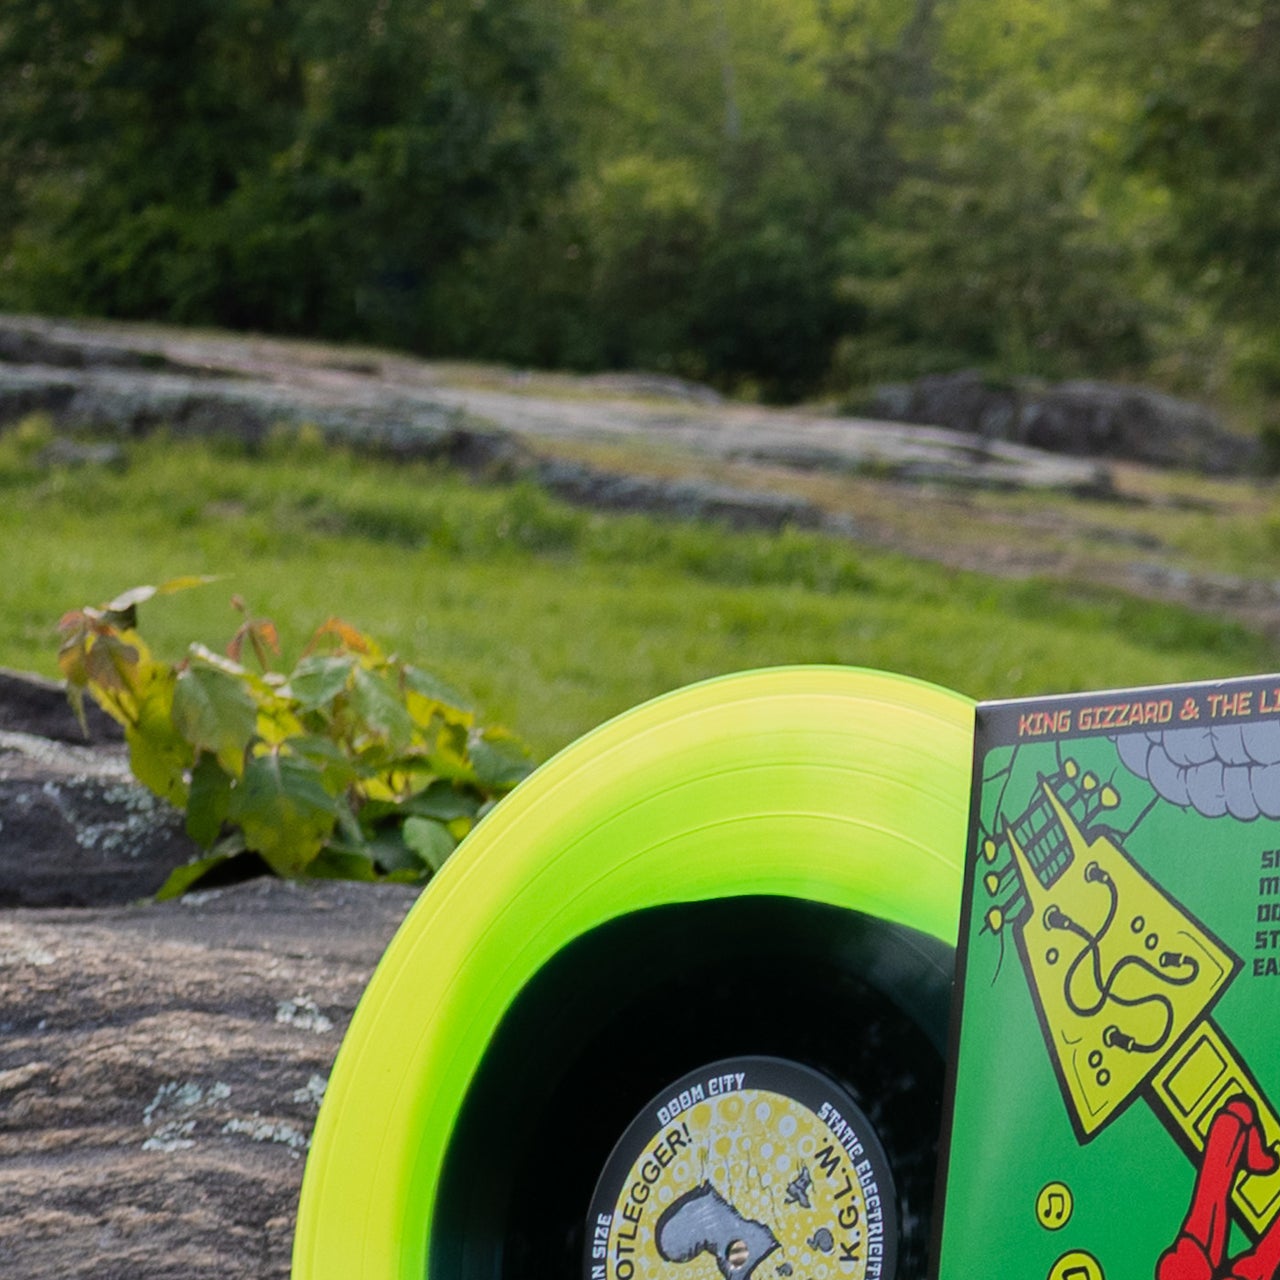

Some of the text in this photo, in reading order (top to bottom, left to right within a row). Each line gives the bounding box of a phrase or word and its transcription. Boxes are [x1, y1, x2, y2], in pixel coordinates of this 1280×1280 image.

[1018, 710, 1071, 736] KING
[1078, 702, 1172, 731] GIZZARD
[1179, 700, 1199, 721] &
[1207, 693, 1252, 717] THE
